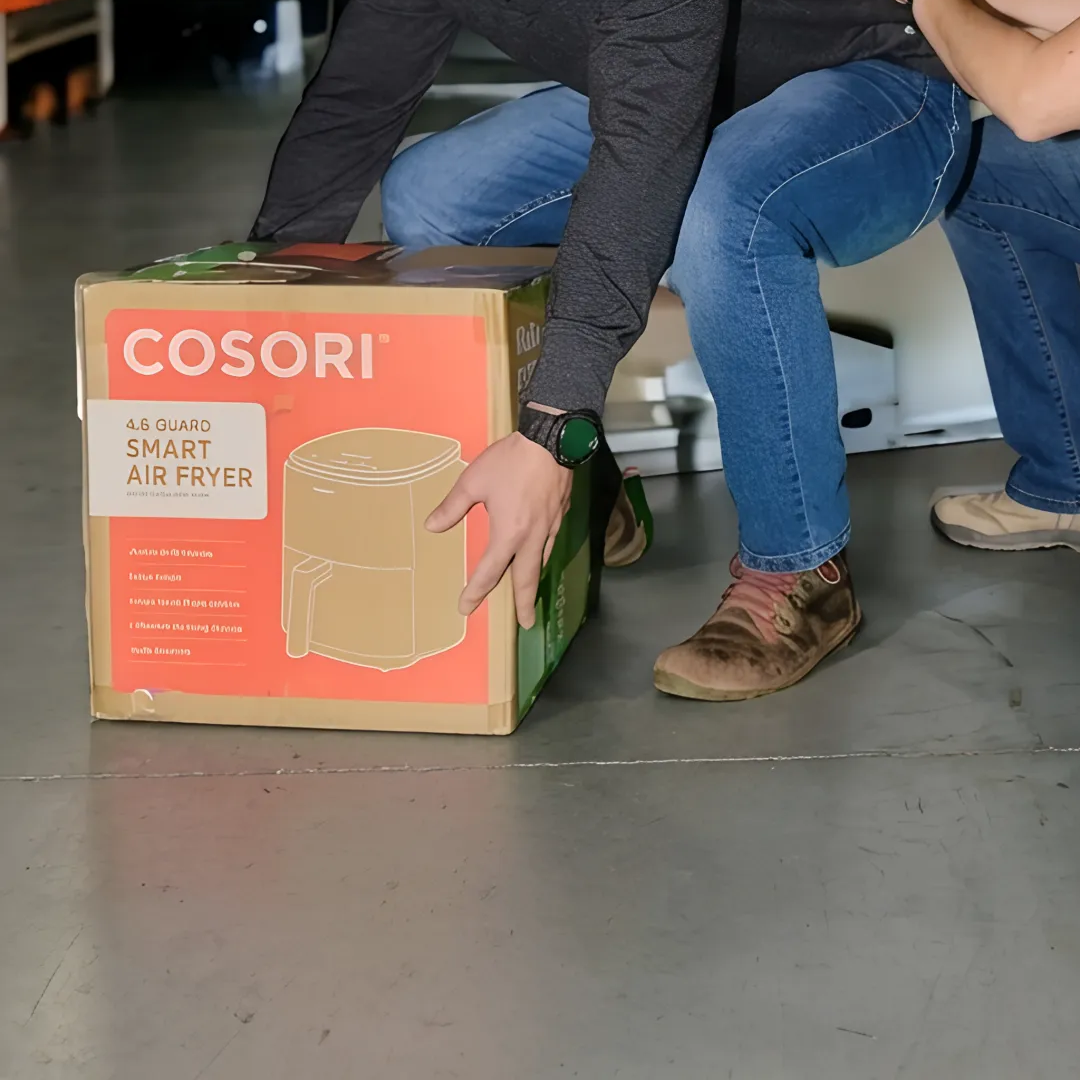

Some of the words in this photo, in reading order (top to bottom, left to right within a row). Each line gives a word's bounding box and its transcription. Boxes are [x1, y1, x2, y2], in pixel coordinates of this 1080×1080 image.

[123, 328, 373, 379] COSORI
[126, 438, 212, 459] SMART
[126, 464, 167, 486] AIR
[176, 466, 253, 487] FRYER
